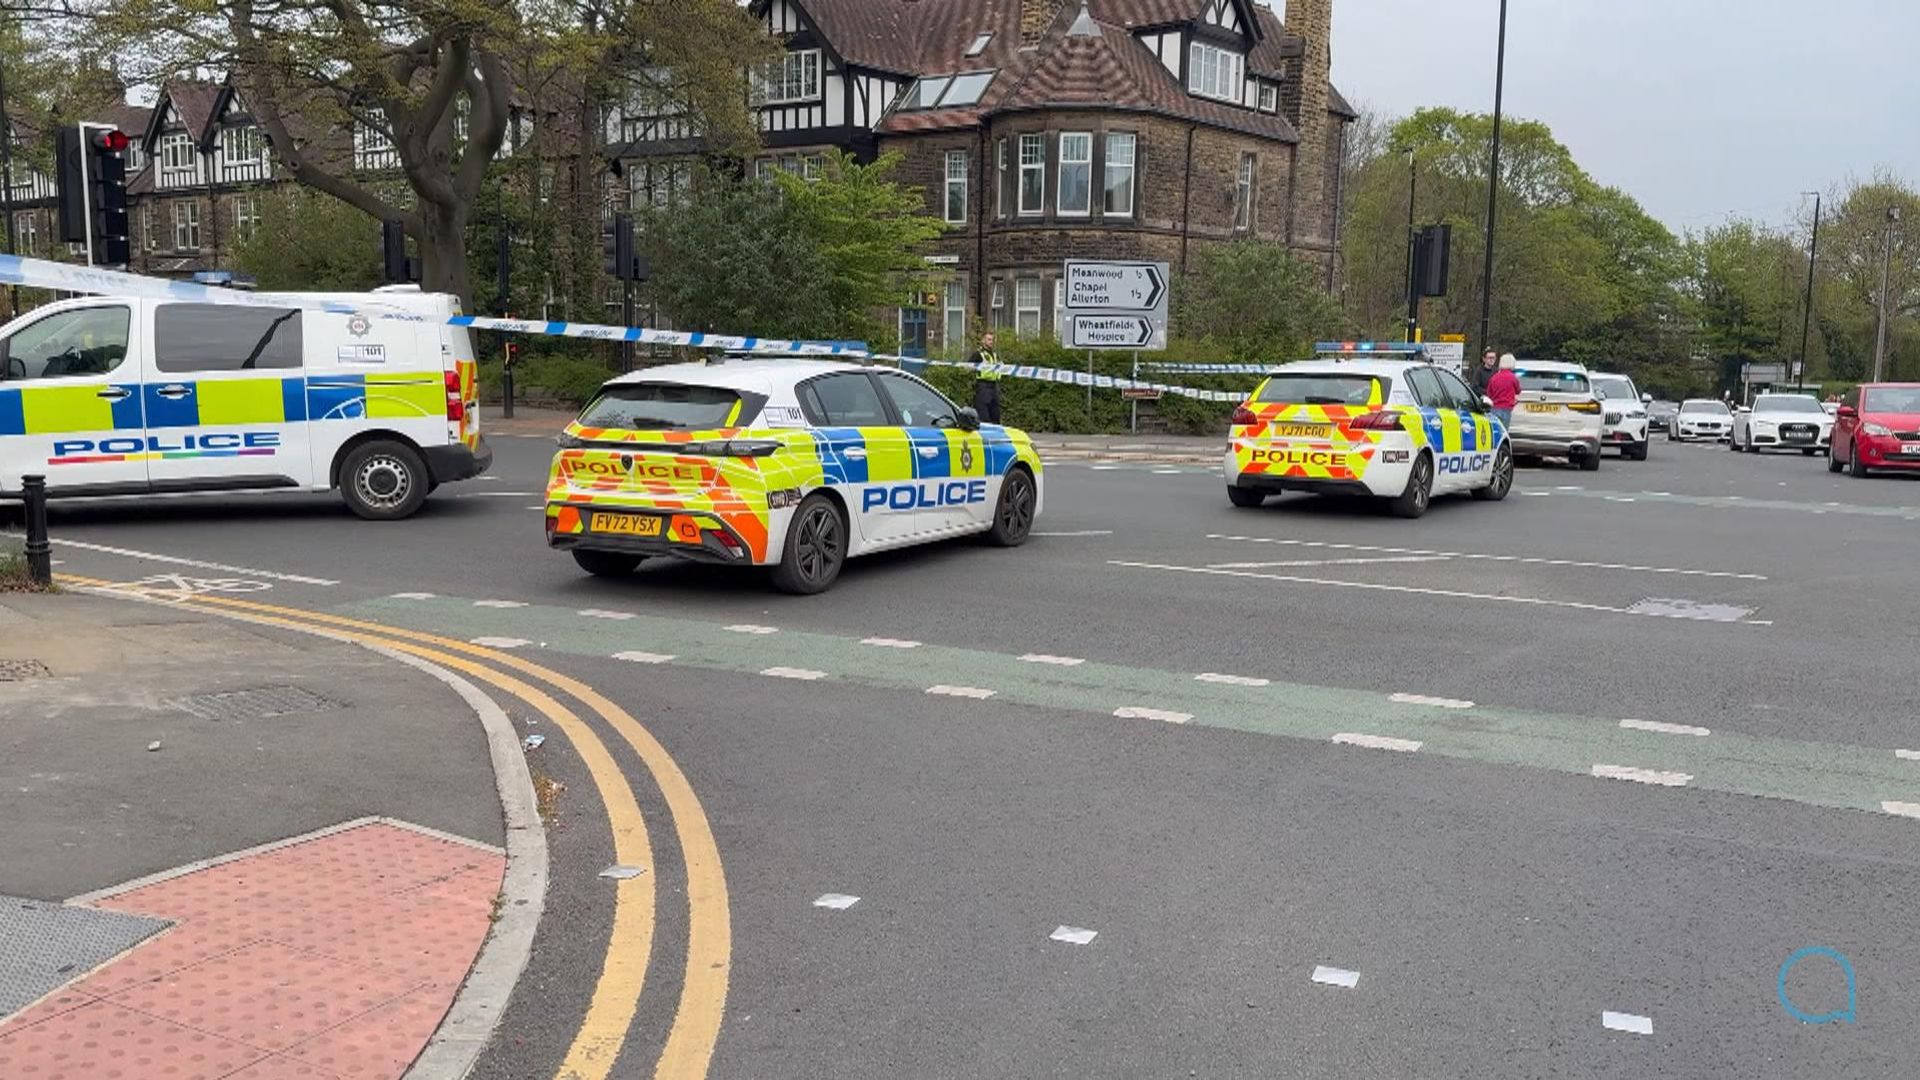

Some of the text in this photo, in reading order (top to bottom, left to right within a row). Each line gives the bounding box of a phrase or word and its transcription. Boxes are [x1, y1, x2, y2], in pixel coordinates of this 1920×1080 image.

[1072, 267, 1123, 279] Meanwood
[1074, 282, 1107, 293] Chapel
[1071, 293, 1110, 304] Allerton
[1078, 319, 1135, 330] Wheatfields
[1088, 331, 1125, 342] Hospice
[365, 347, 382, 356] 101
[787, 408, 802, 420] 101
[1280, 425, 1302, 436] YJ71
[53, 432, 280, 456] POLICE
[1251, 450, 1346, 465] POLICE
[572, 459, 694, 480] POLICE
[862, 480, 986, 513] POLICE
[596, 514, 657, 532] FV72 YSX
